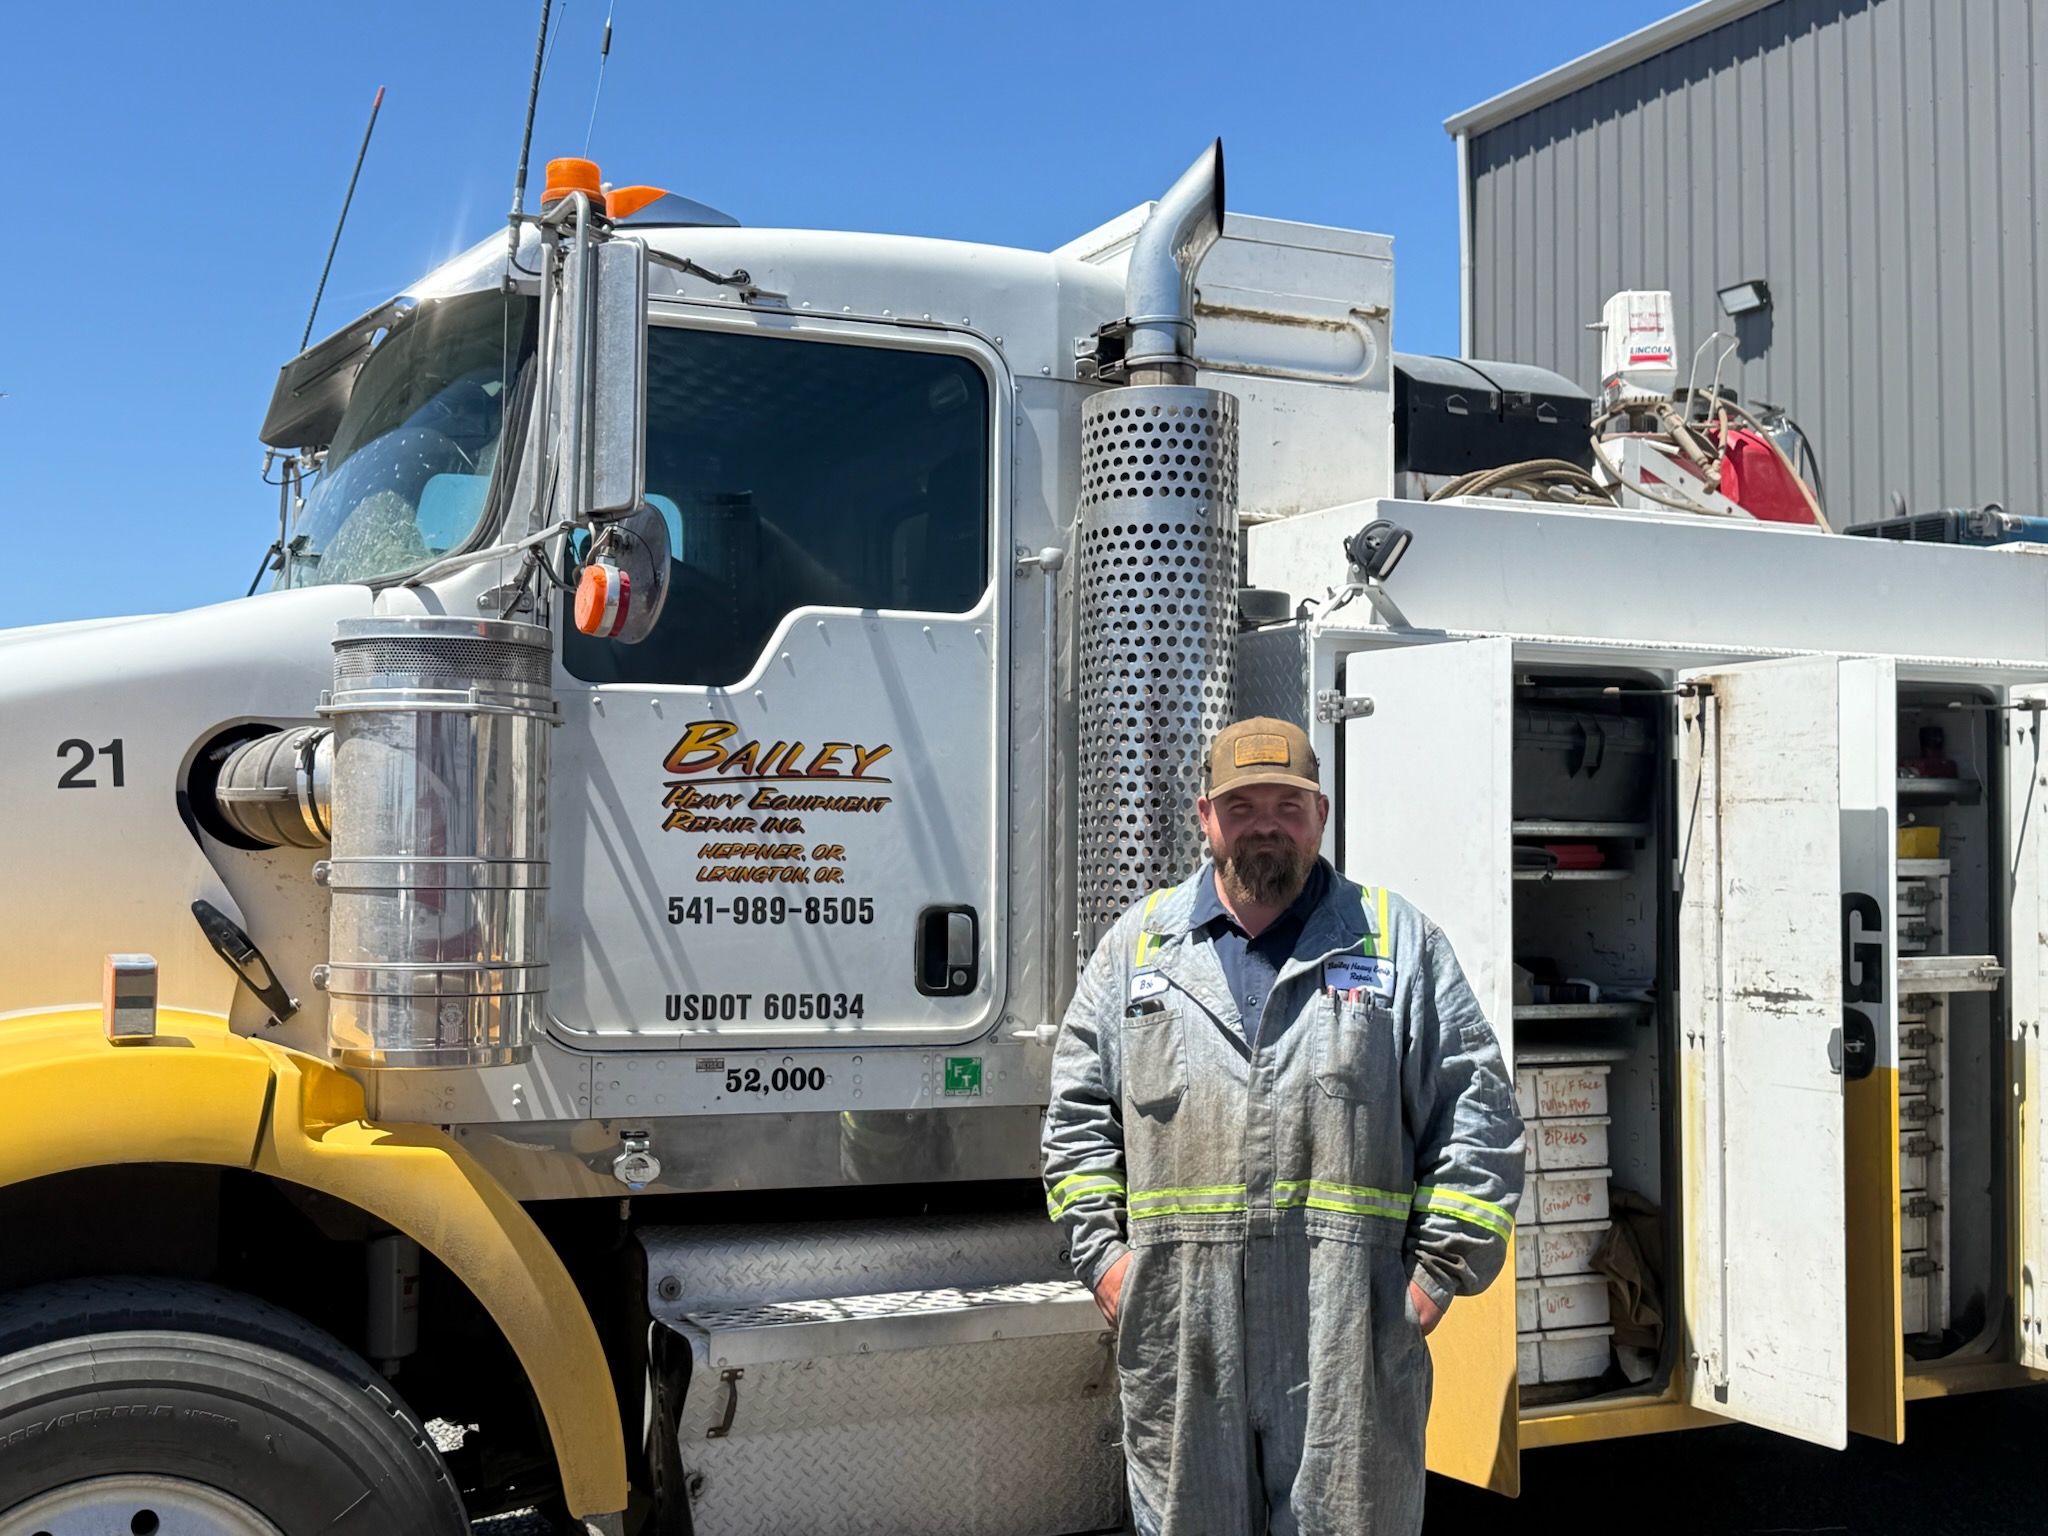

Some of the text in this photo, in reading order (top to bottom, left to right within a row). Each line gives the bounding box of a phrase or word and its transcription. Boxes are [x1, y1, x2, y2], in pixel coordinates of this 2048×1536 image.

[662, 719, 893, 777] BAILEY
[56, 738, 125, 789] 21
[661, 785, 893, 813] HEAVY EQUIPMENT
[661, 808, 758, 834] REPAIR
[697, 843, 847, 861] HEPPNER, OR.
[695, 865, 845, 884] LEXINGTON, OR.
[667, 896, 874, 925] 541-989-8505
[1327, 961, 1350, 971] Bailey
[1350, 962, 1373, 973] Heavy
[1350, 972, 1374, 982] Repair
[665, 993, 864, 1021] USDOT 605034
[725, 1067, 825, 1095] 52,000
